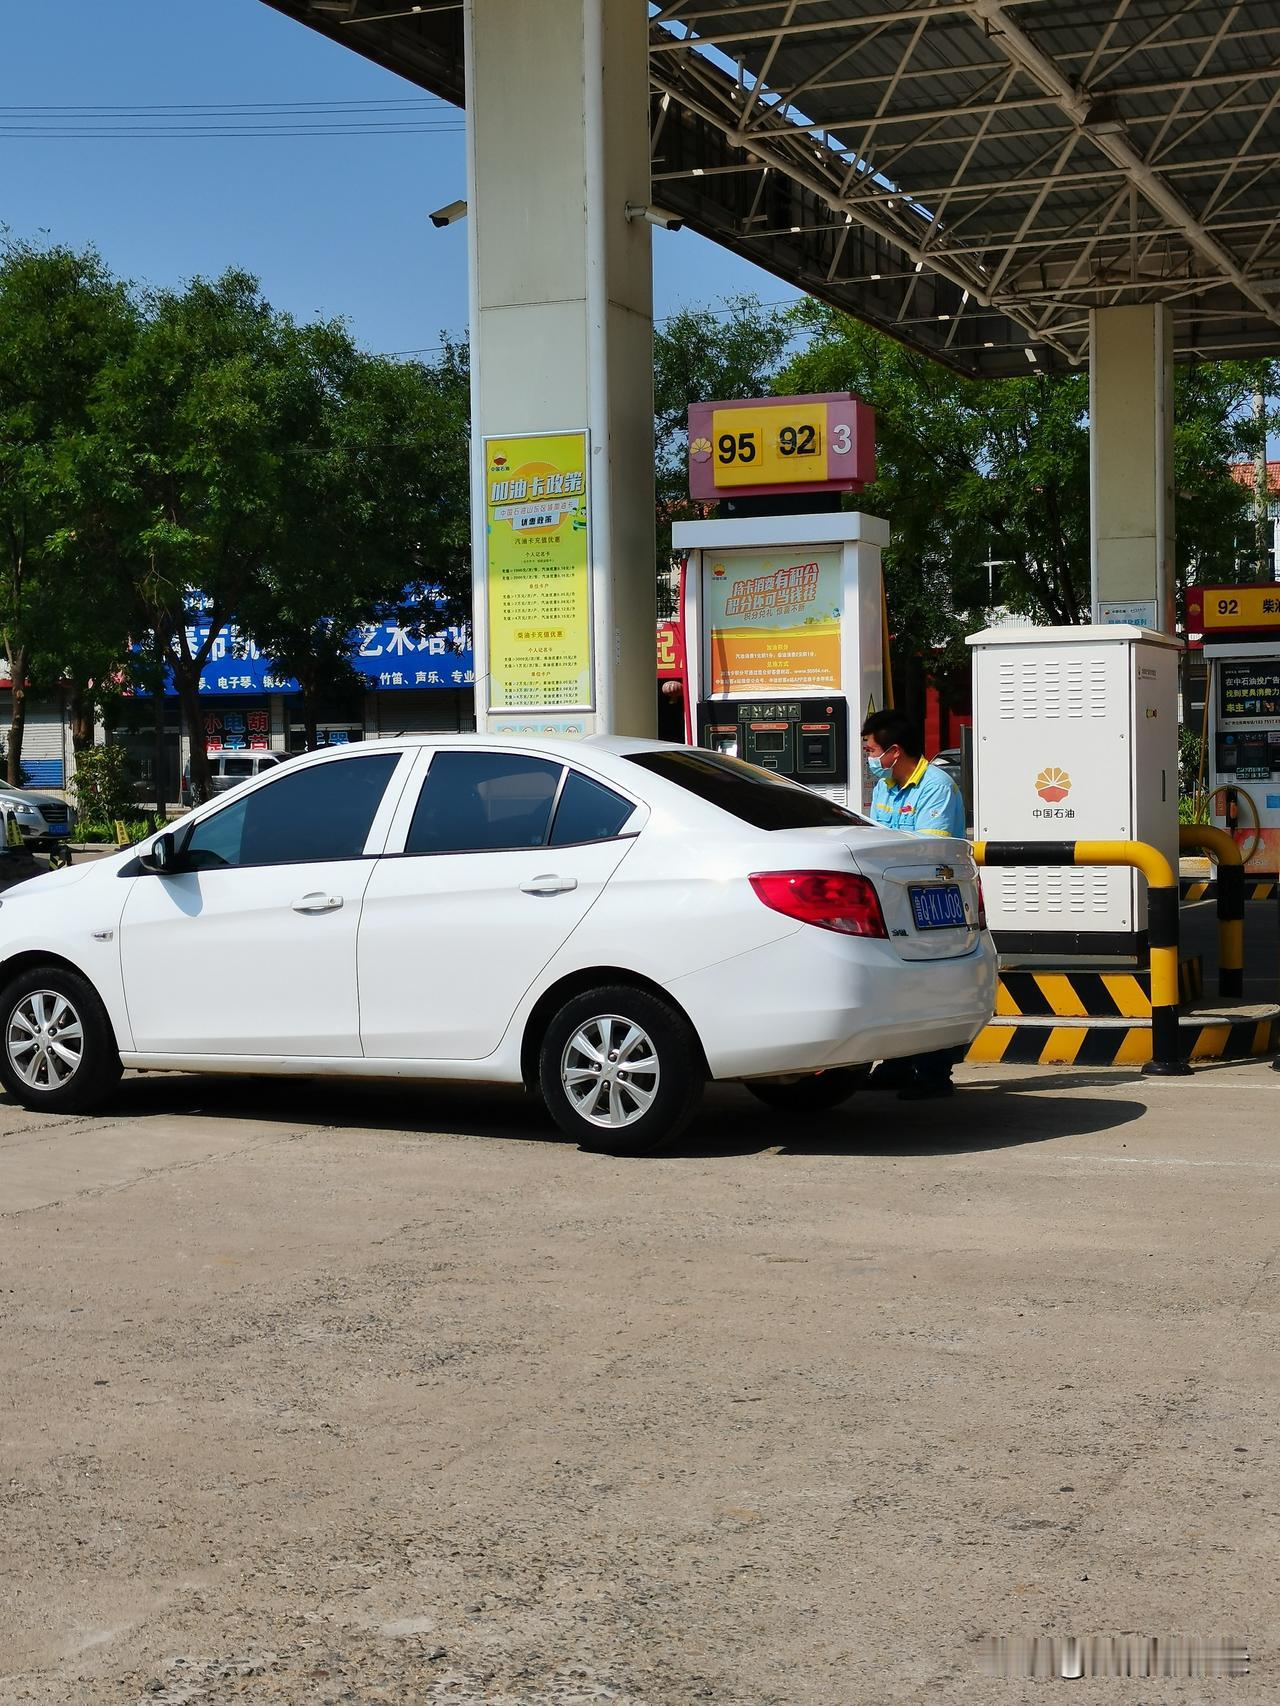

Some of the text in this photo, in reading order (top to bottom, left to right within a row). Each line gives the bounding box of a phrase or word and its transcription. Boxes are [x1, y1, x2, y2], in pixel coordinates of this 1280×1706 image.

[719, 424, 853, 464] 95 92 3
[491, 471, 585, 503] 加油卡政策
[1218, 600, 1239, 615] 92
[1032, 808, 1075, 819] 中国石油
